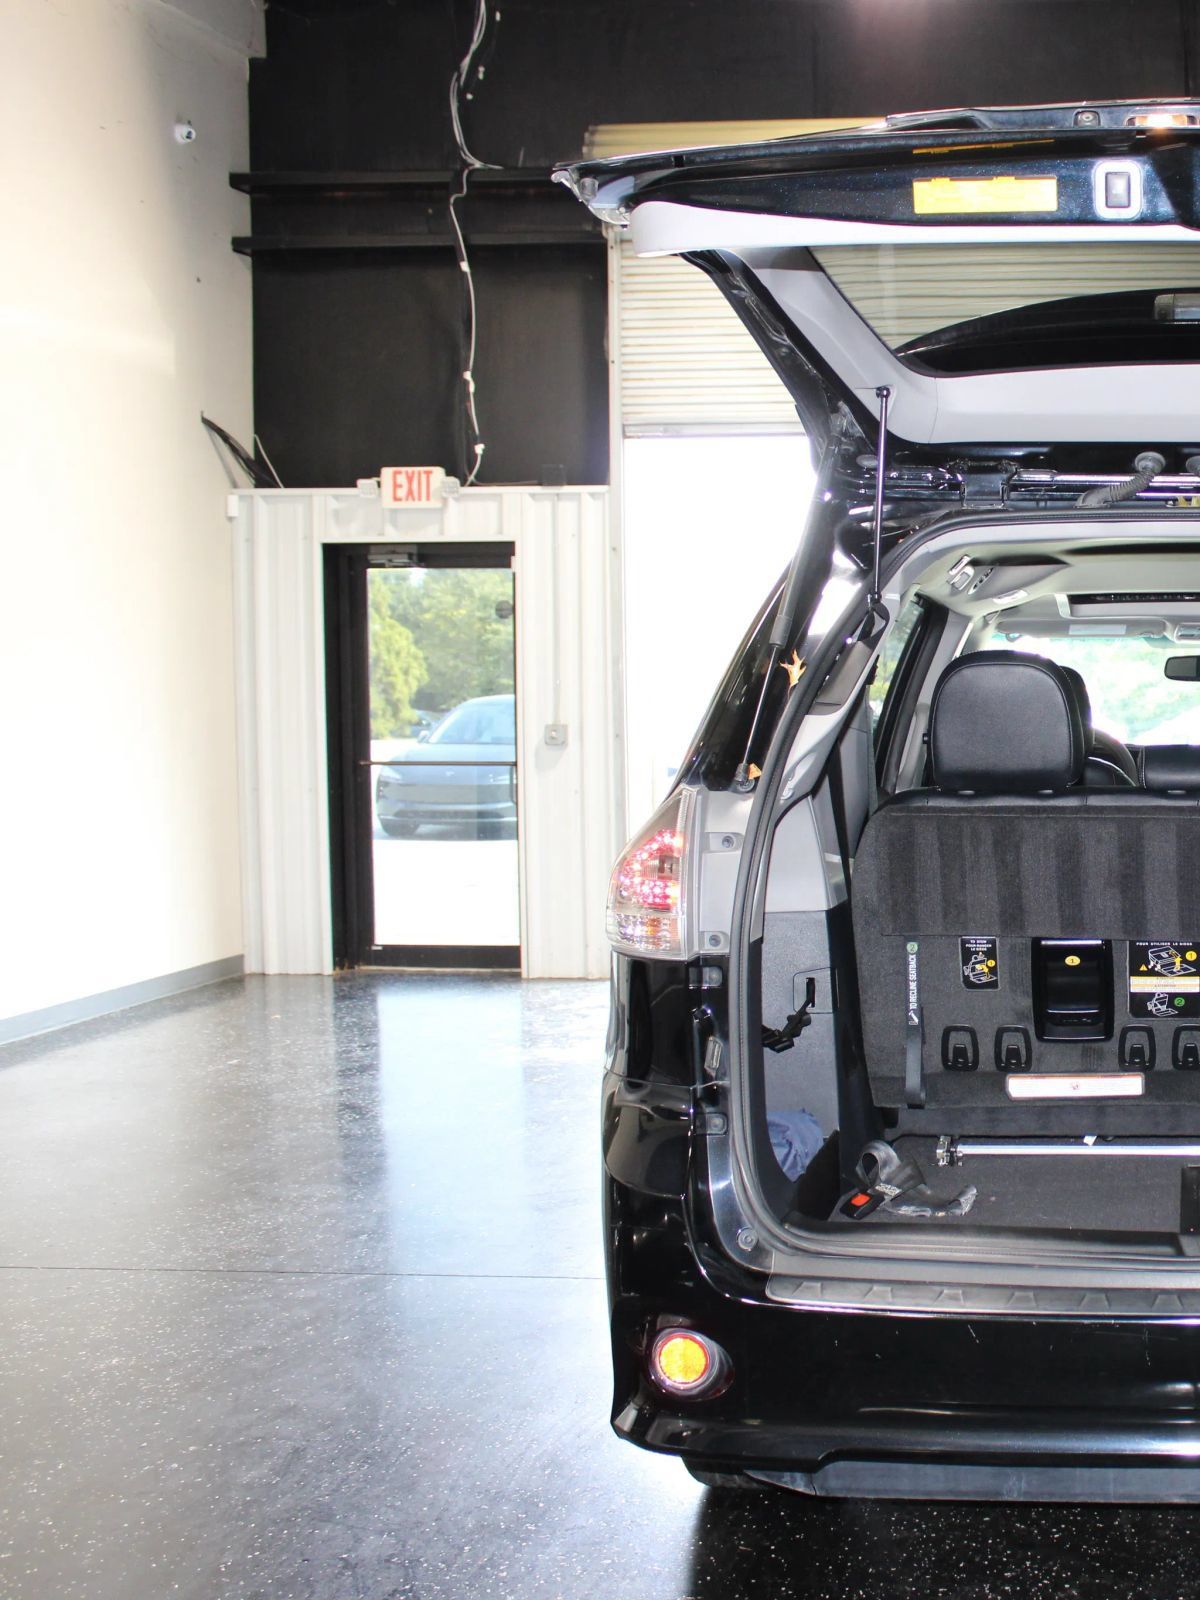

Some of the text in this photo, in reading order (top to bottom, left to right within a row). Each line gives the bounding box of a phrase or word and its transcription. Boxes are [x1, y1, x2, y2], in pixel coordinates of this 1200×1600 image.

[392, 469, 433, 502] EXIT
[908, 954, 917, 980] SEATBACK
[909, 981, 917, 1002] RECLINE
